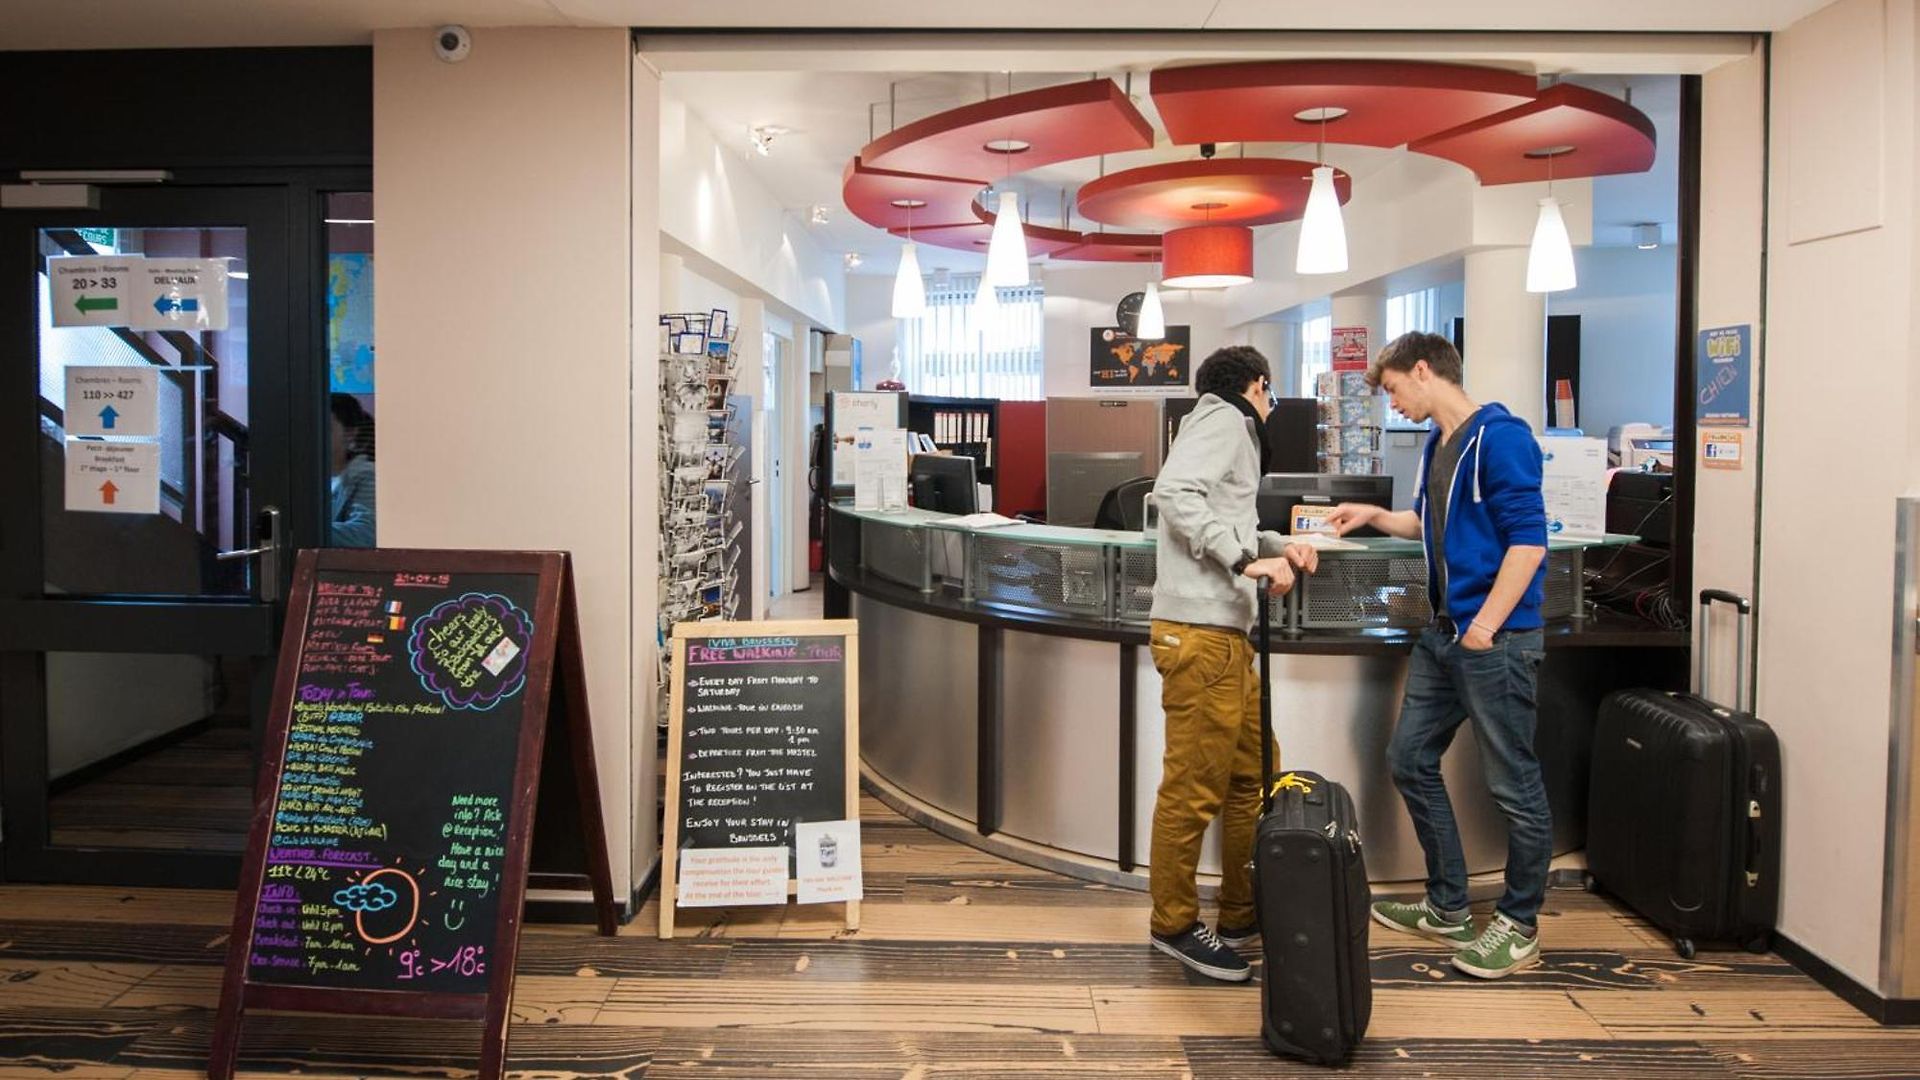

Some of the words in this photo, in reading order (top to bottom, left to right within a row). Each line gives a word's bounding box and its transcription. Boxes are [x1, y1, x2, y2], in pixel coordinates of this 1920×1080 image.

[72, 278, 88, 290] 20
[101, 277, 117, 289] 33
[82, 390, 102, 400] 110
[117, 390, 135, 399] 427
[688, 645, 727, 662] FREE
[698, 676, 725, 687] EVERY
[728, 676, 745, 686] DAY
[747, 676, 769, 685] FROM
[786, 768, 814, 778] HAVE
[686, 817, 720, 829] ENJOY
[725, 817, 747, 828] YOUR
[750, 817, 774, 827] STAY
[438, 855, 458, 875] day
[460, 858, 480, 871] and
[482, 860, 490, 871] a
